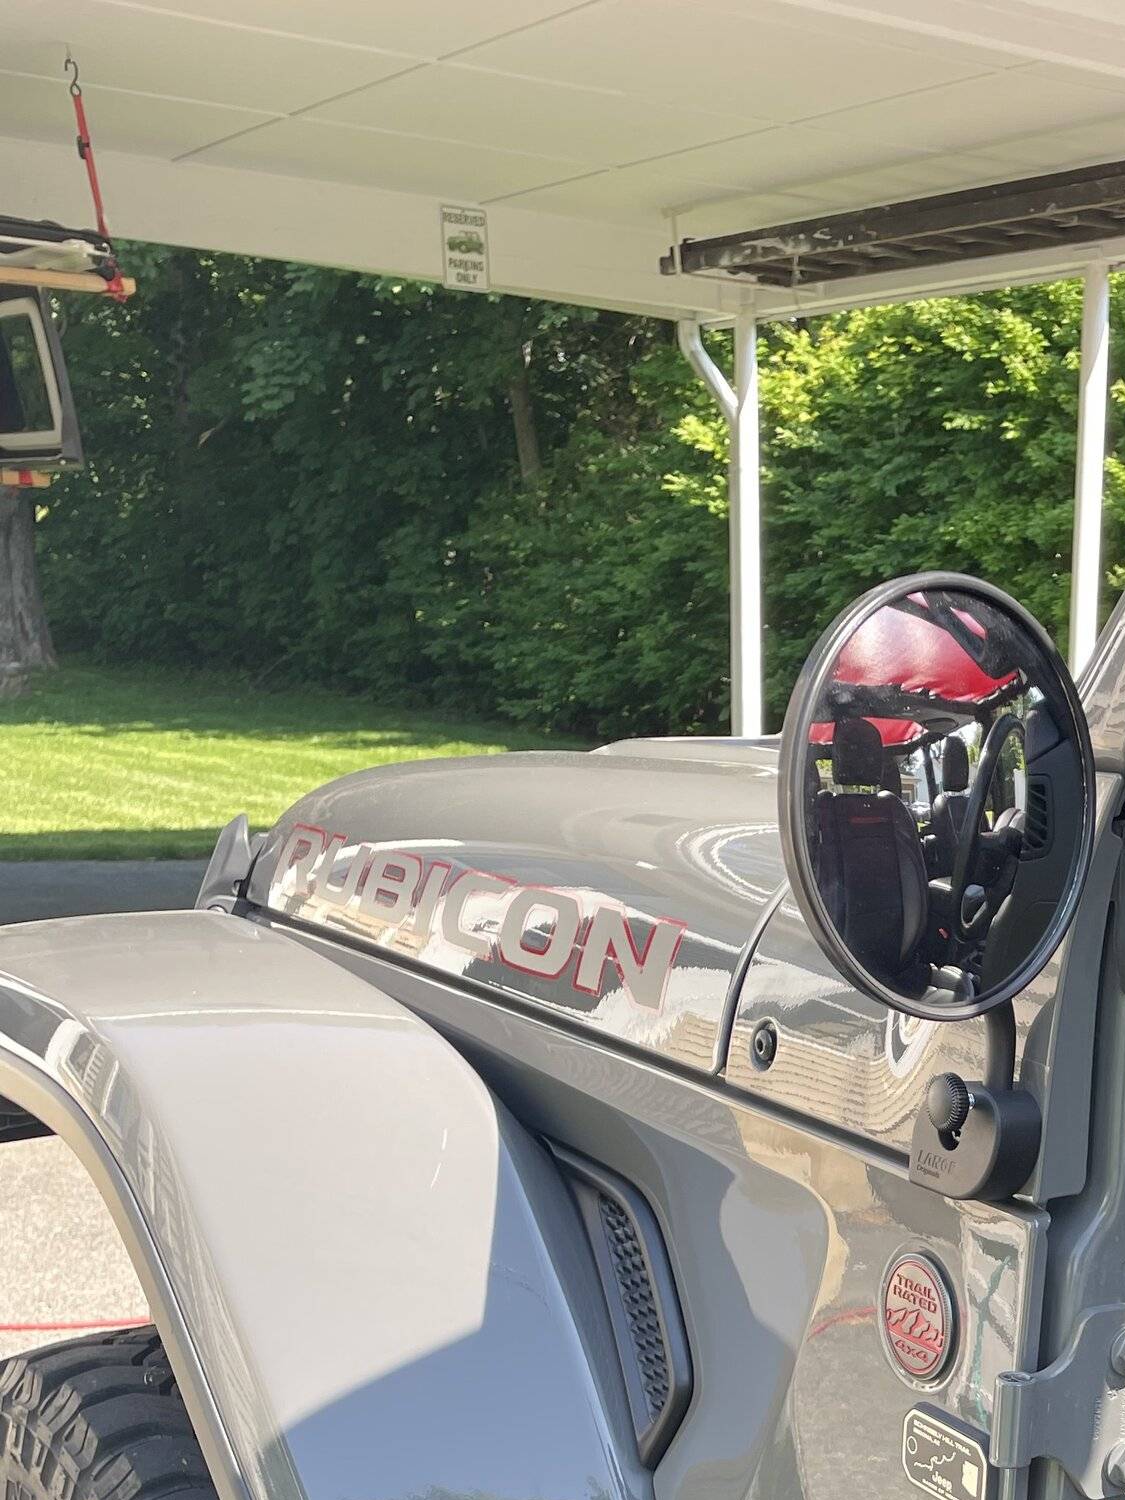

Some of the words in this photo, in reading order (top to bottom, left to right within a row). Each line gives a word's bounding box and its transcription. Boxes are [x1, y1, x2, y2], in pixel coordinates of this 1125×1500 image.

[269, 823, 688, 1015] RUBICON
[893, 1284, 937, 1313] RATED
[897, 1273, 935, 1301] TRAIL
[932, 1471, 953, 1493] Jeep
